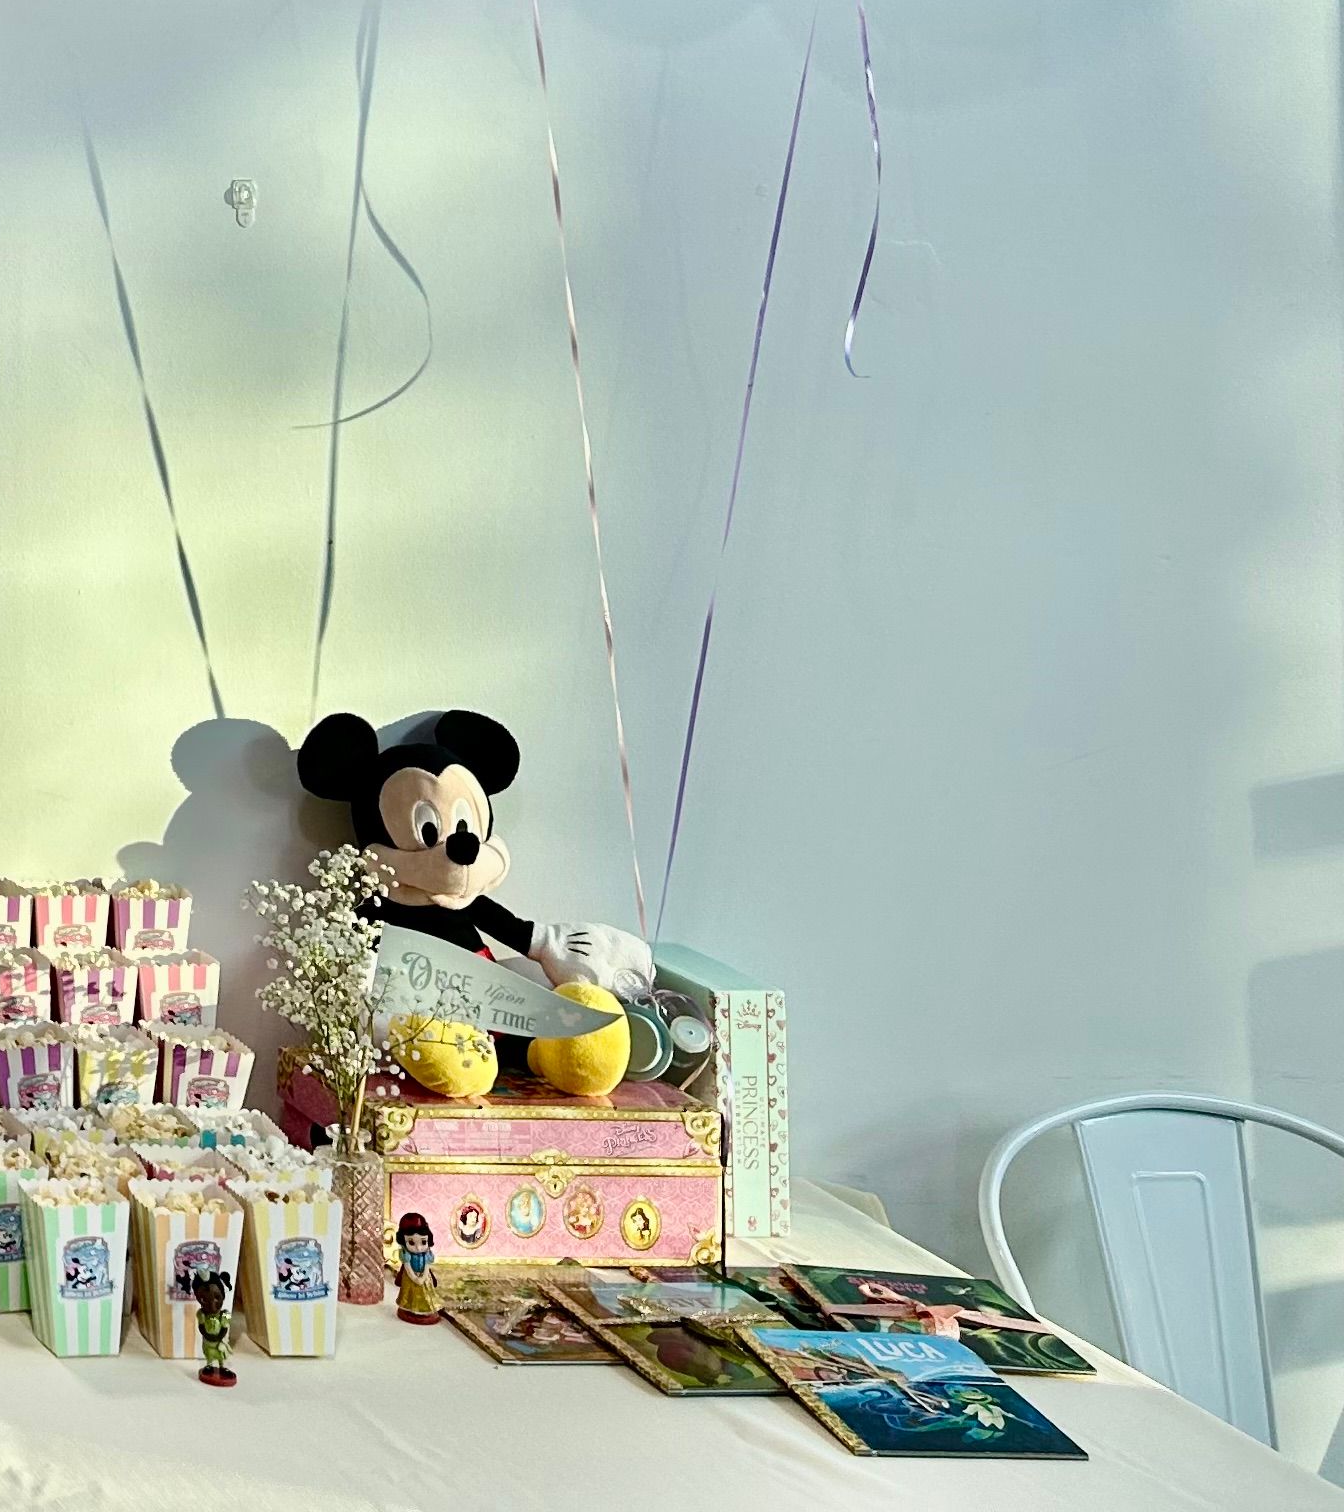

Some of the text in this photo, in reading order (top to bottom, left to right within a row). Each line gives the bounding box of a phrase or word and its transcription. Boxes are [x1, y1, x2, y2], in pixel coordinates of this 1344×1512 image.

[490, 1007, 536, 1032] TIME
[742, 1075, 759, 1171] PRINCESS
[856, 1337, 948, 1362] LUCA
